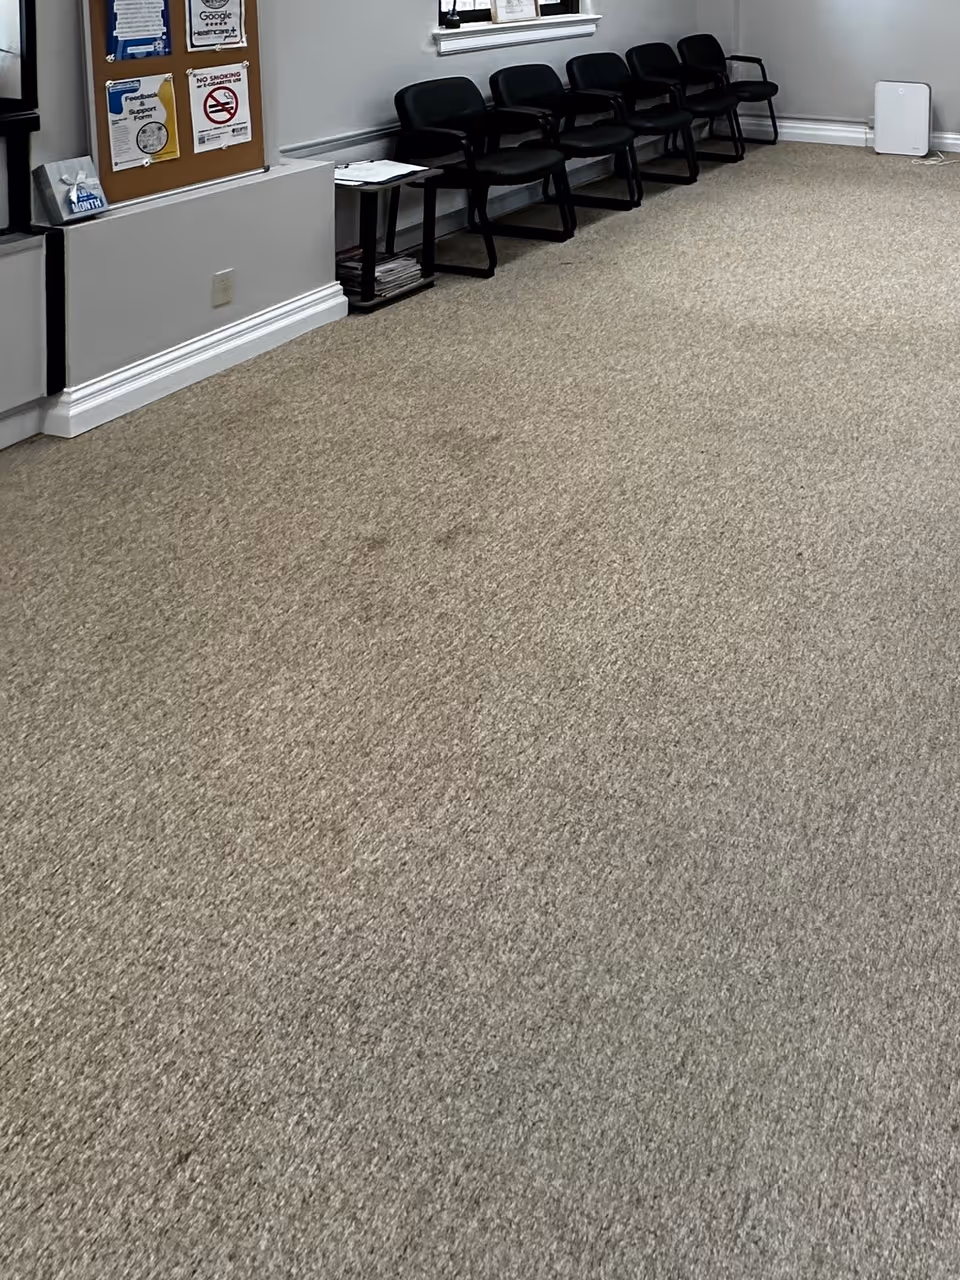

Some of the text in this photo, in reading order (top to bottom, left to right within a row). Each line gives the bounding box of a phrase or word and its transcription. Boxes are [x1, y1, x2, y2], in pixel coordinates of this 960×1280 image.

[199, 10, 232, 22] Google
[196, 76, 208, 84] NO
[209, 71, 241, 82] SMOKING
[124, 91, 158, 102] Feedback
[128, 106, 157, 116] Support
[133, 113, 153, 121] Form
